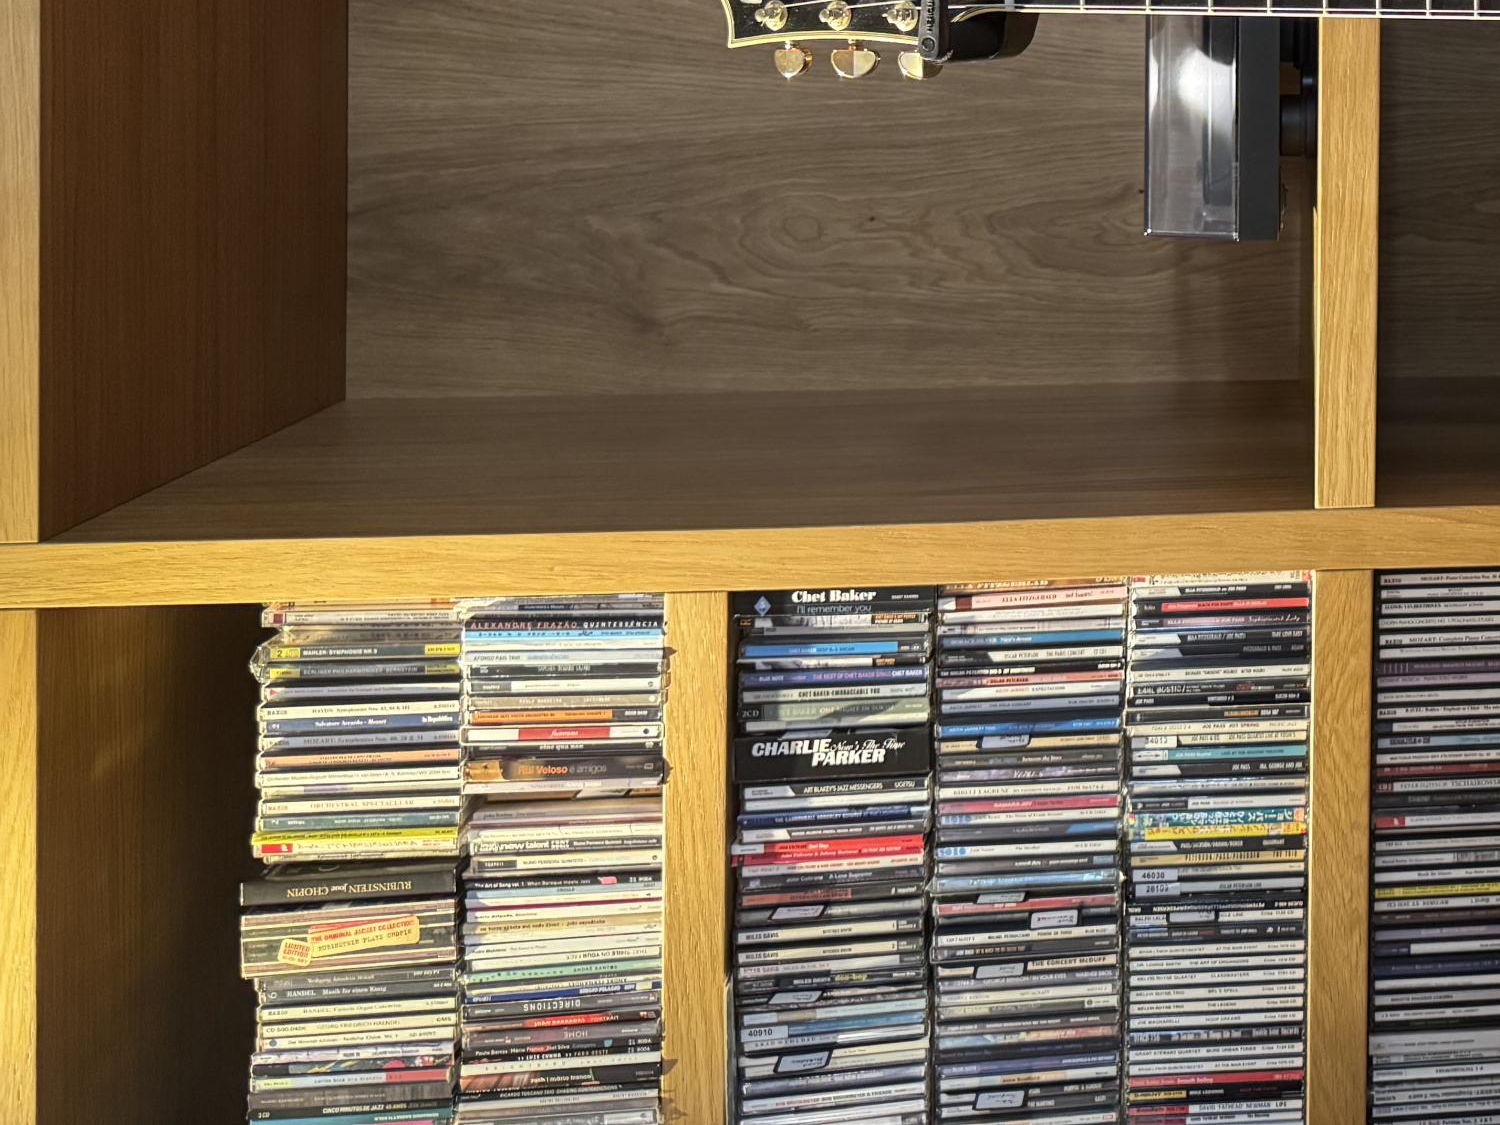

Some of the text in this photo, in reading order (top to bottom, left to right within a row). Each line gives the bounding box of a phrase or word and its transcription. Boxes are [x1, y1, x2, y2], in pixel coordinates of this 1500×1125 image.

[792, 590, 876, 603] Chet Baker
[808, 605, 851, 614] remember
[853, 605, 871, 614] you
[752, 739, 831, 757] CHARLIE
[831, 738, 906, 752] Now's The Time
[812, 749, 886, 767] PARKER
[535, 765, 568, 774] Veloso
[577, 765, 607, 774] amigos
[526, 841, 549, 850] talent
[287, 881, 412, 898] RUBINSTEIN joue CHOPIN
[312, 934, 321, 942] THE
[323, 930, 352, 940] ORIGINAL
[284, 942, 310, 952] LIMITED
[283, 949, 309, 958] EDITION
[834, 973, 867, 981] doo-bop
[523, 1000, 581, 1011] DIRECTIONS
